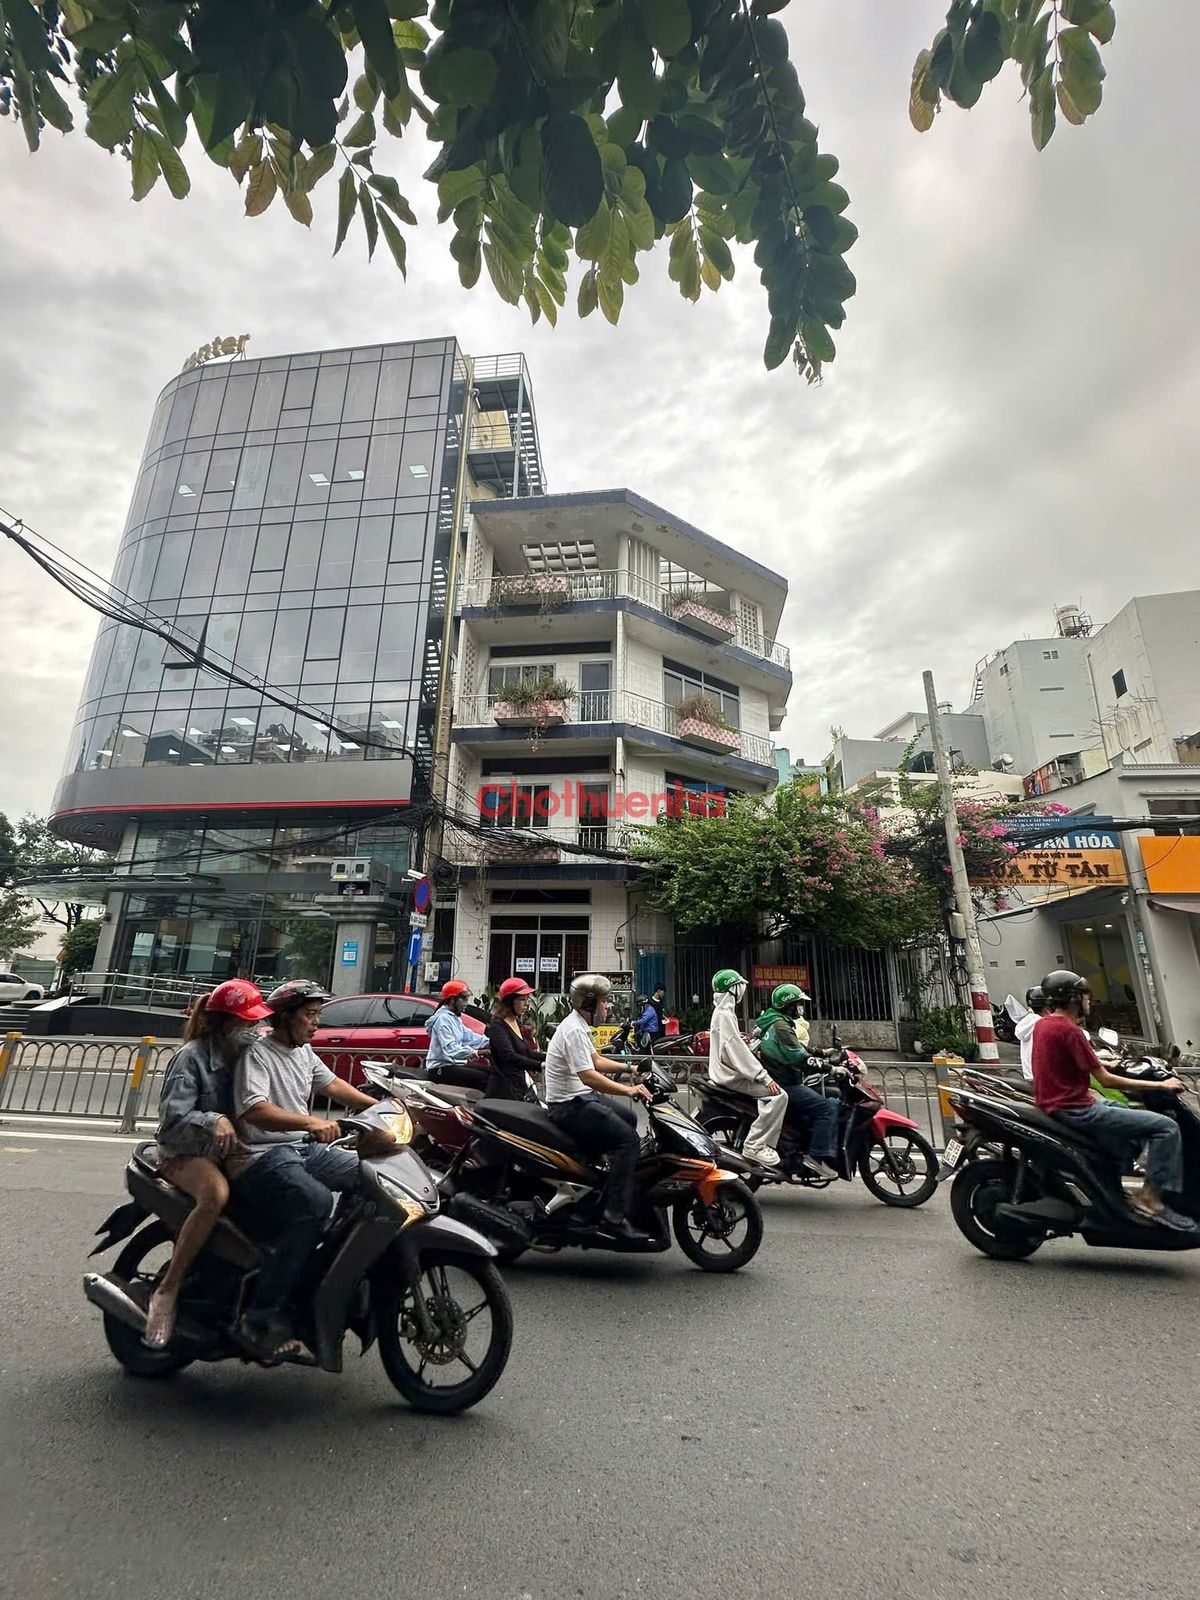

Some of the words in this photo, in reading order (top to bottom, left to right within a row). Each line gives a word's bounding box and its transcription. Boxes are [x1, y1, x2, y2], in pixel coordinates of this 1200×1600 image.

[1075, 833, 1115, 848] HÓA
[1065, 860, 1110, 879] TÂN
[781, 993, 795, 1001] Grab
